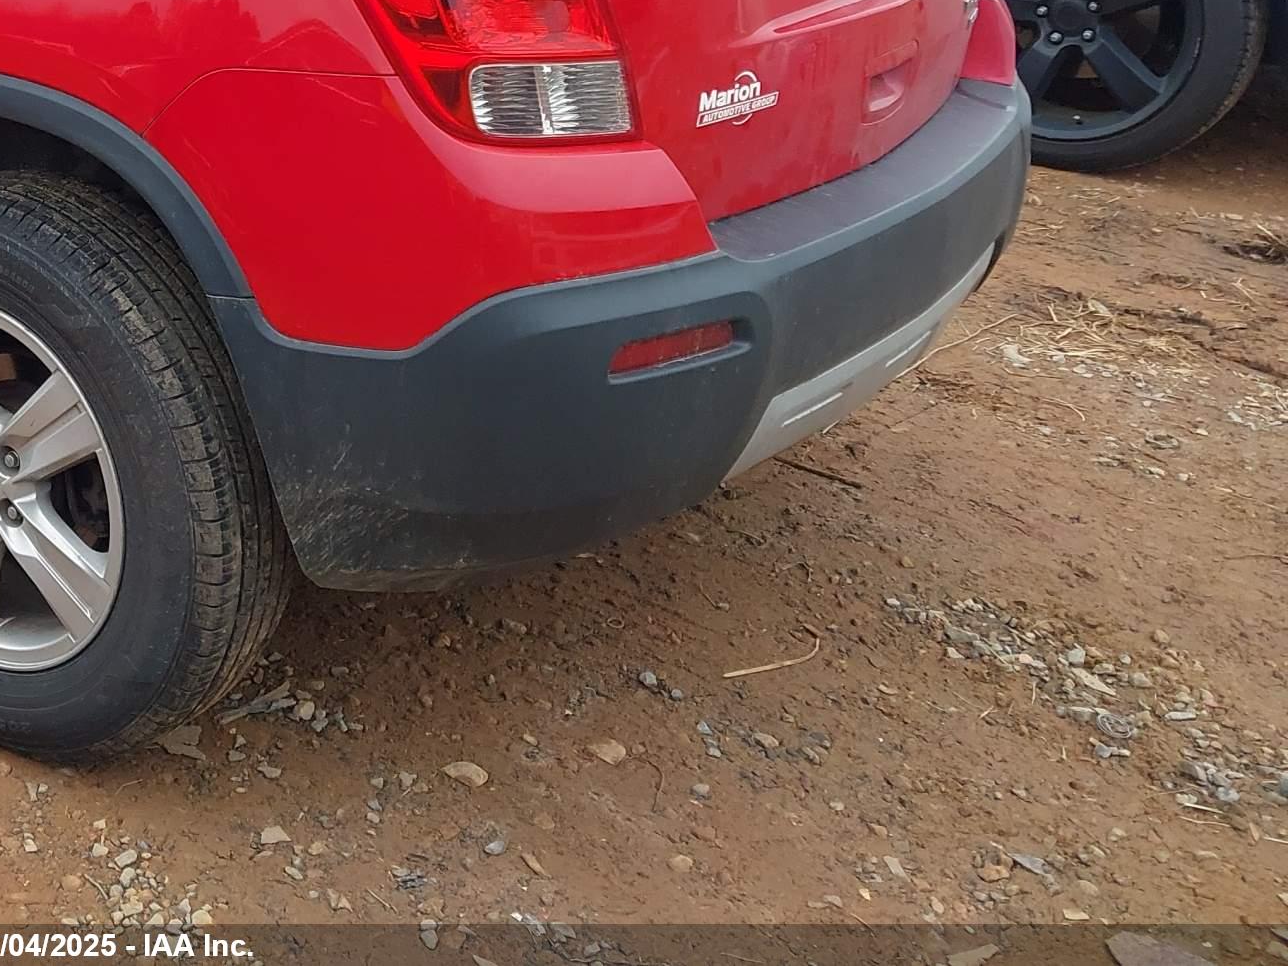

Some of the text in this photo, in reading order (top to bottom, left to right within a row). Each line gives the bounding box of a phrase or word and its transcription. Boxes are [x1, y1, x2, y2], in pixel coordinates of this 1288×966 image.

[699, 82, 761, 112] Marion
[702, 95, 775, 123] AUTOMOTIVE GROUP
